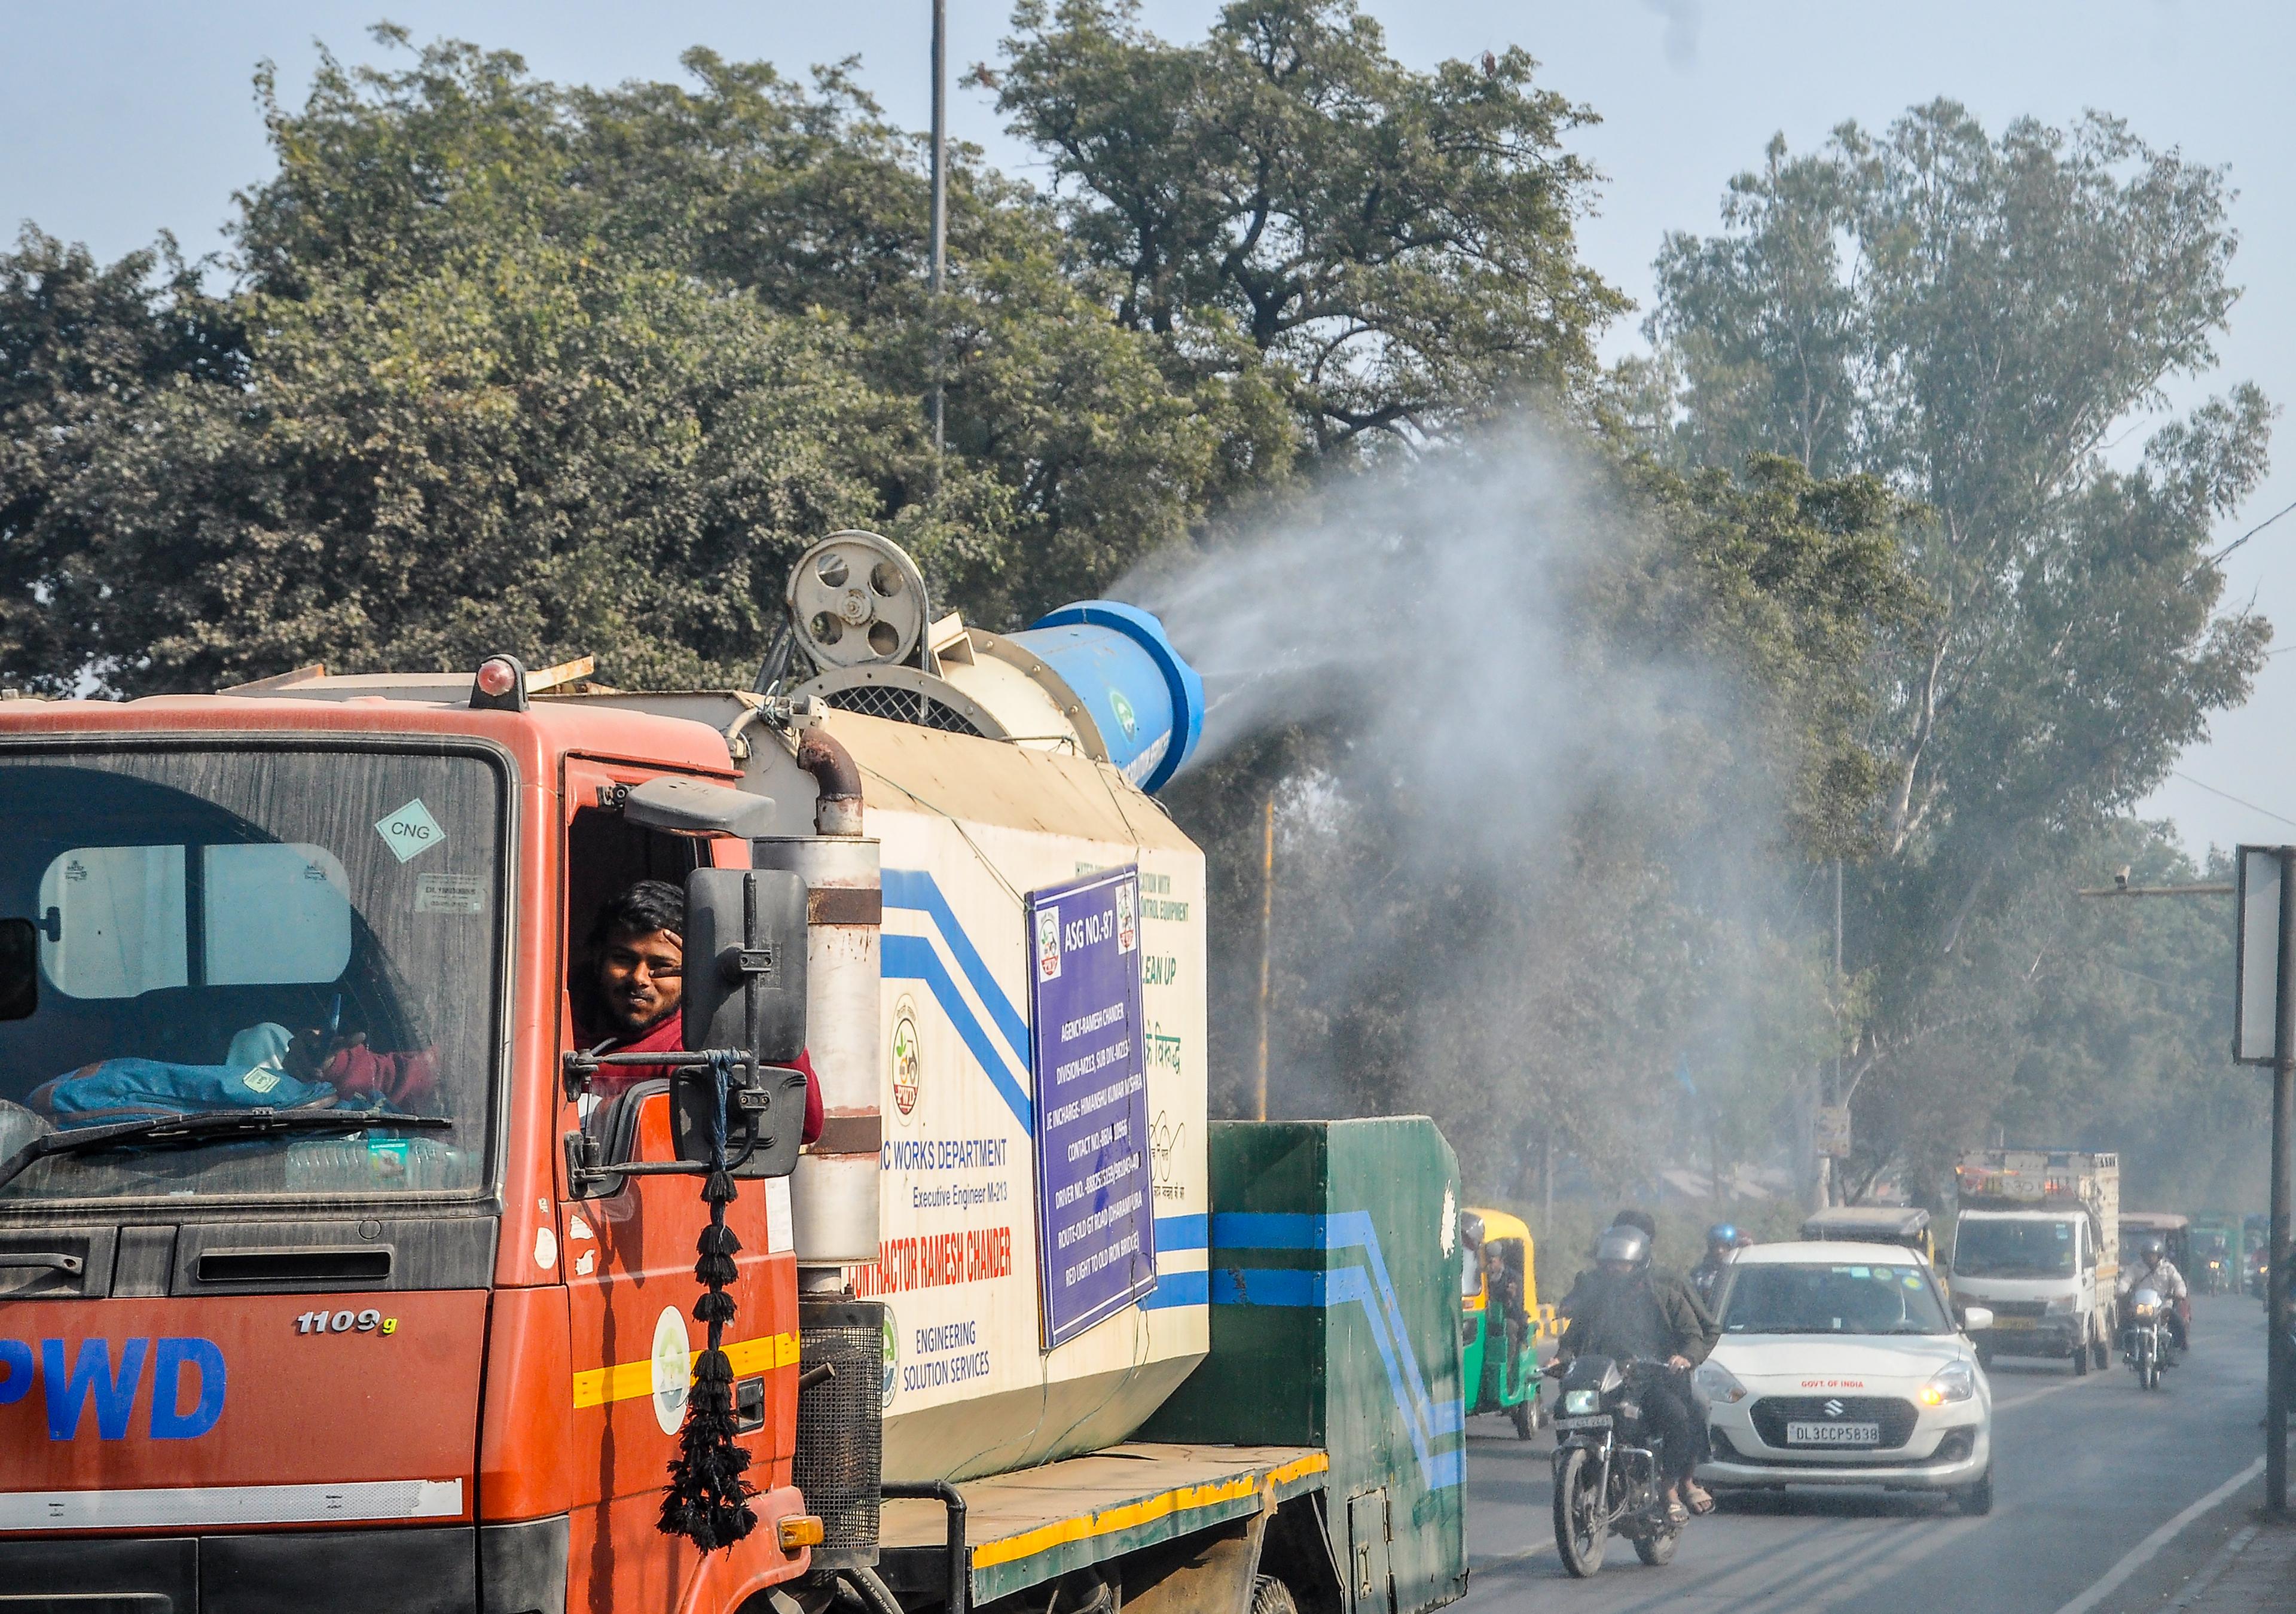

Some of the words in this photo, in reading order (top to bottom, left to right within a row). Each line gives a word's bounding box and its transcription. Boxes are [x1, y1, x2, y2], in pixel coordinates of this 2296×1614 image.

[391, 822, 430, 839] CNG
[1161, 900, 1189, 922] EQUIPMENT
[1065, 919, 1083, 952] ASG
[1142, 955, 1162, 984] LEAN
[1164, 957, 1176, 986] UP
[1103, 1002, 1124, 1026] CHANDER
[1096, 1049, 1106, 1069] SUB
[1080, 1088, 1107, 1116] HIMANSHU
[1107, 1080, 1125, 1104] KUMAR
[893, 1140, 935, 1170] WORKS
[938, 1138, 1007, 1169] DEPARTMENT
[1067, 1135, 1091, 1162] CONTACT
[913, 1185, 951, 1208] Executive
[952, 1183, 986, 1210] Engineer
[987, 1181, 1007, 1203] M-213
[1055, 1185, 1074, 1210] DRIVER
[1087, 1215, 1094, 1234] GT
[1094, 1208, 1108, 1231] ROAD
[921, 1232, 964, 1288] RAMESH
[967, 1226, 1012, 1283] CHANDER
[1065, 1266, 1076, 1287] RED
[1076, 1258, 1091, 1282] LIGHT
[1091, 1253, 1098, 1273] TO
[1098, 1249, 1109, 1269] OLD
[1109, 1241, 1120, 1263] IRON
[916, 1320, 976, 1354] ENGINEERING
[903, 1359, 948, 1392] SOLUTION
[951, 1350, 990, 1383] SERVICES
[1797, 1427, 1877, 1440] DL3CCP5838
